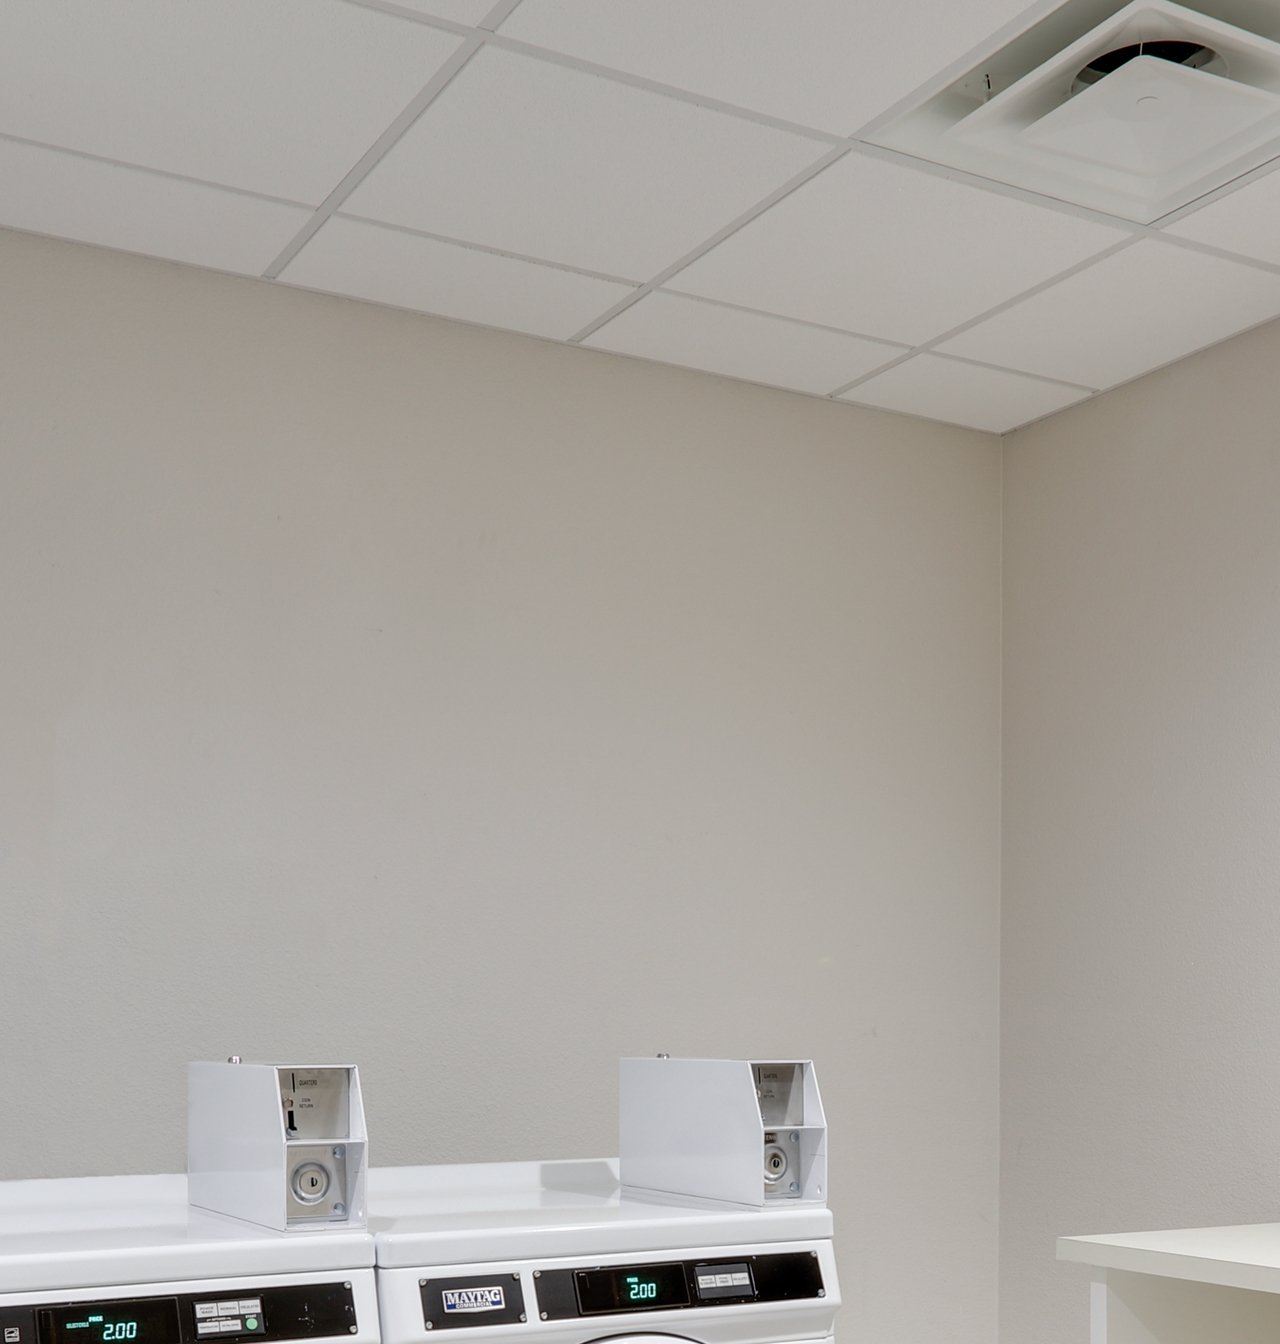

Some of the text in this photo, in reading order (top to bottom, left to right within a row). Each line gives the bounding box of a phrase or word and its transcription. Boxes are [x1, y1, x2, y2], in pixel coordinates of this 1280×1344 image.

[445, 1289, 501, 1305] MAYTAG
[630, 1283, 656, 1299] 2.00
[455, 1301, 493, 1309] COMMERCIAL
[103, 1322, 137, 1340] 2.00
